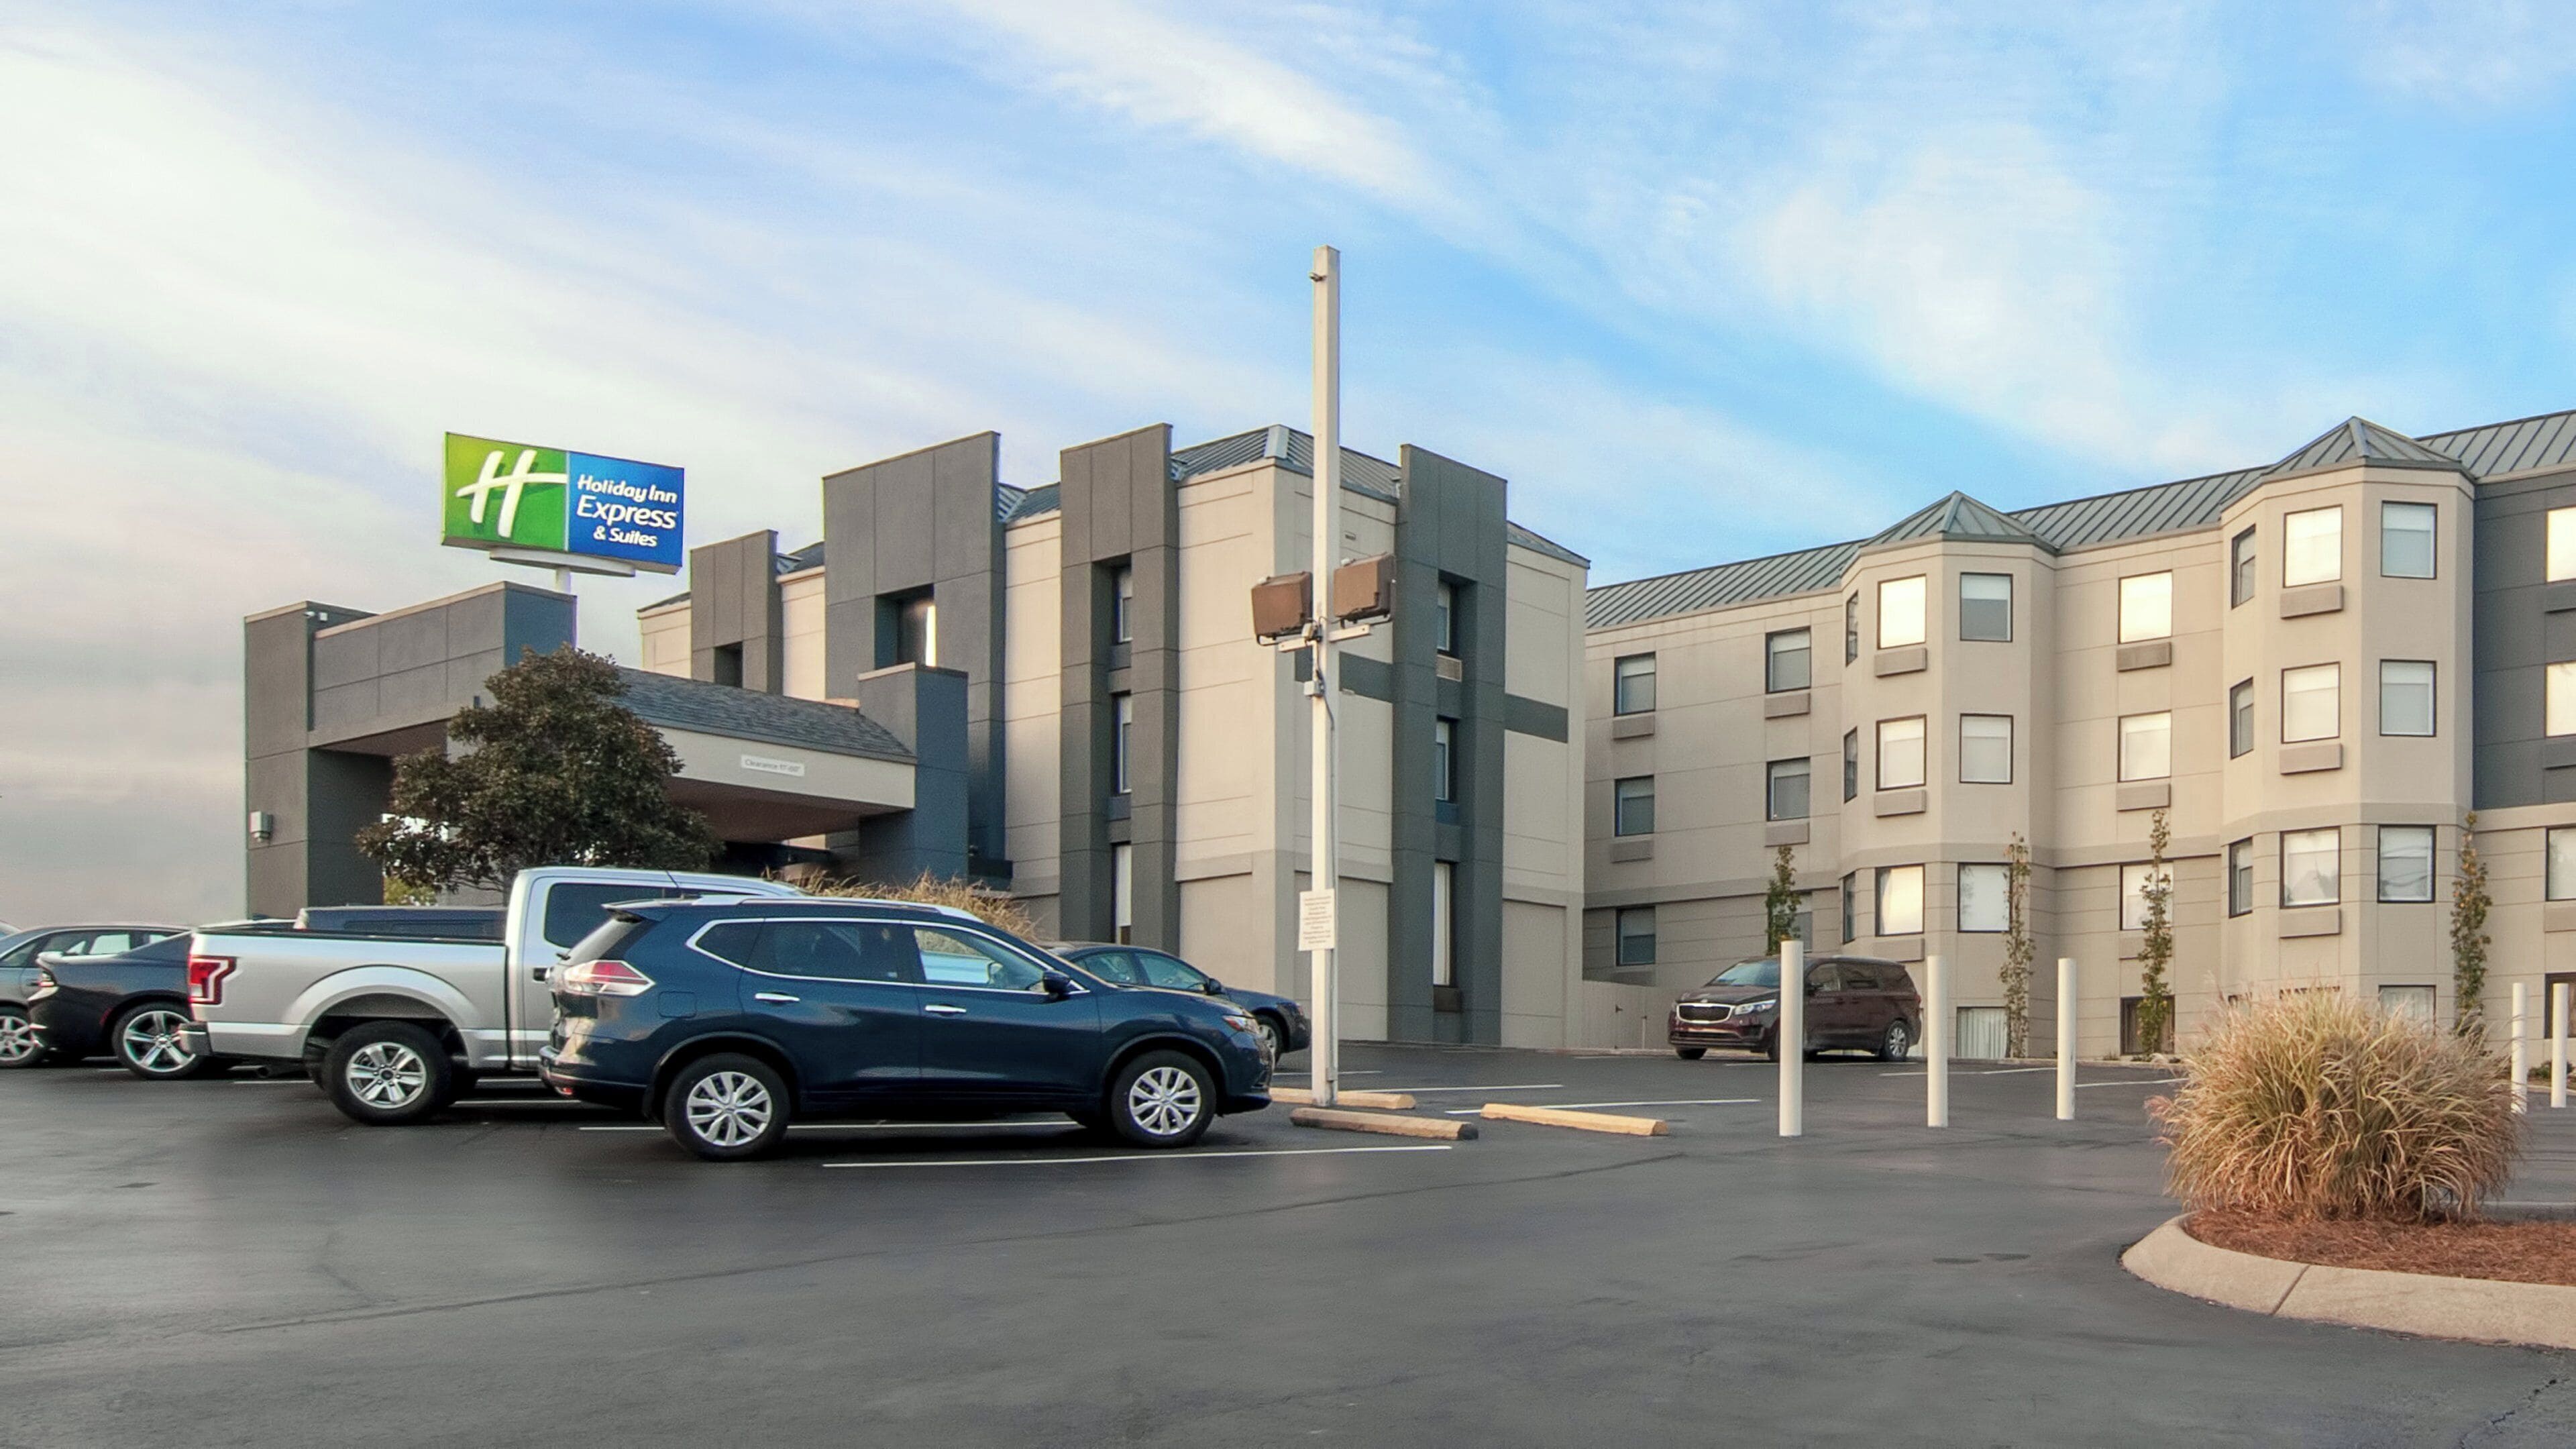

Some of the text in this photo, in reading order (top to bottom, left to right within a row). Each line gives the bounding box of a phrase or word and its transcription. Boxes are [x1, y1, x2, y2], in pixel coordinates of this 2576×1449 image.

[577, 474, 678, 503] Holiday Inn
[576, 494, 678, 529] Express
[593, 525, 658, 547] & Suites
